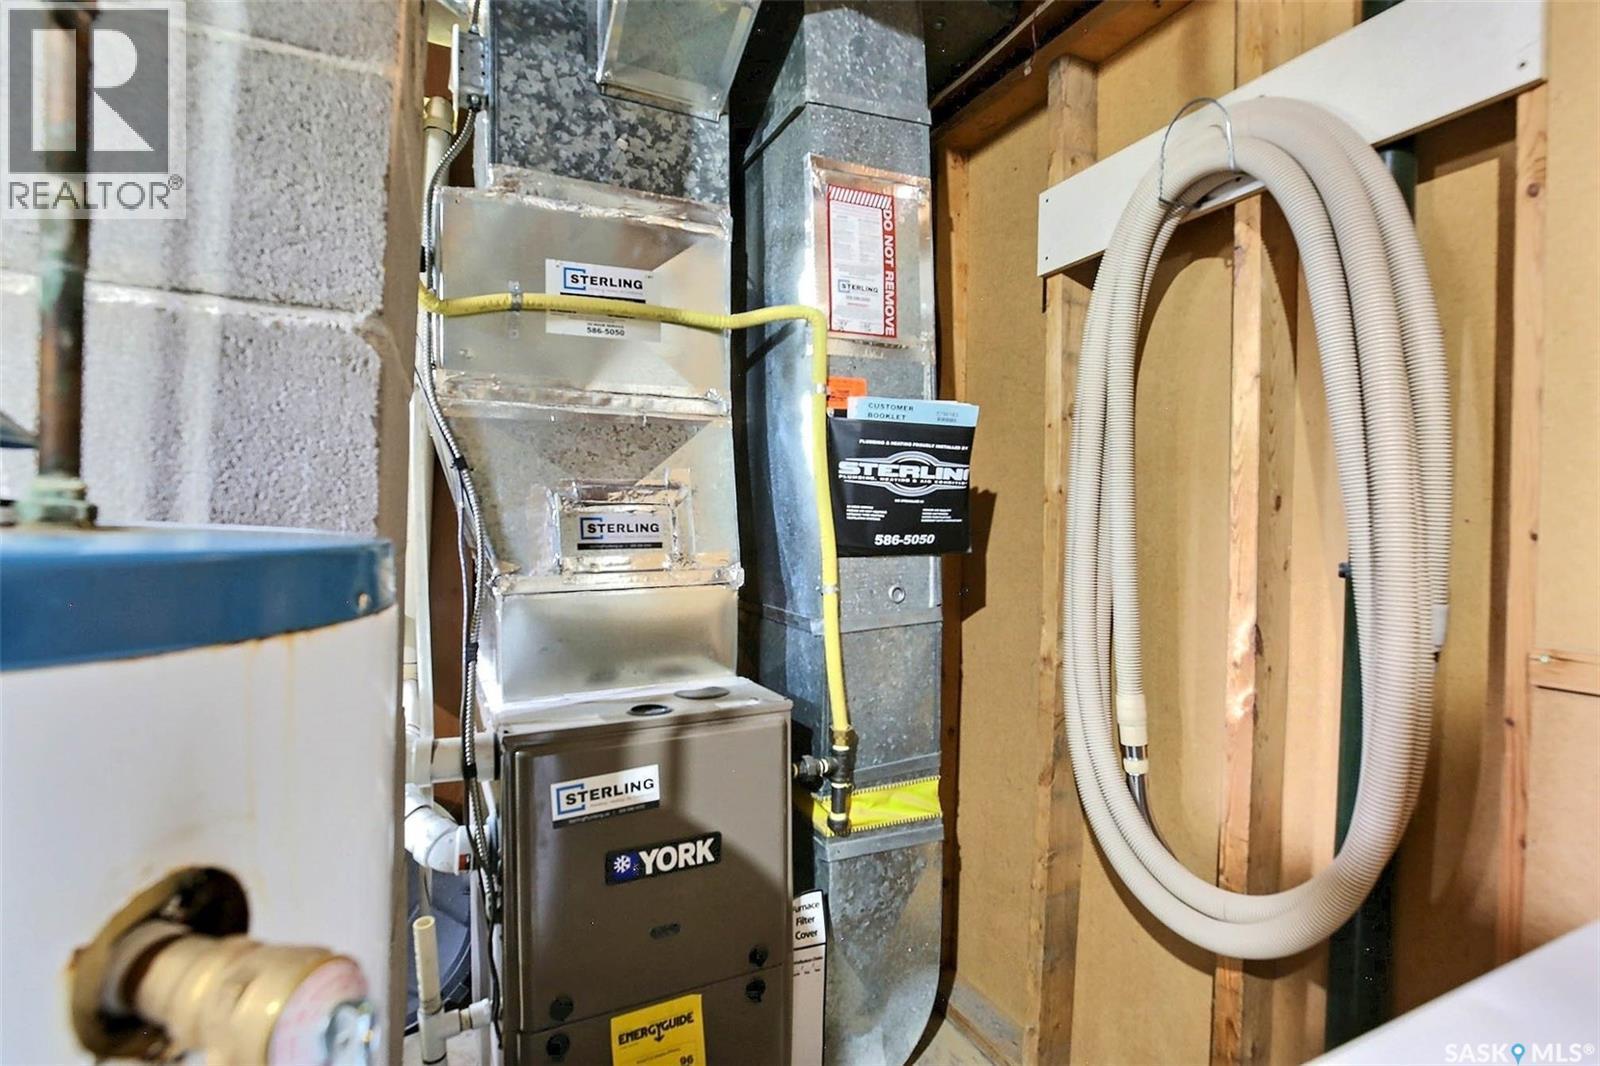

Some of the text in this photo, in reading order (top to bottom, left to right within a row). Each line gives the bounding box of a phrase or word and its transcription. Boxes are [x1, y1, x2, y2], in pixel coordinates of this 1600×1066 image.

[883, 208, 896, 336] DO NOT REMOVE
[570, 273, 643, 290] STERLING
[841, 283, 879, 293] STERLING
[586, 326, 625, 336] 586-5050
[868, 402, 914, 412] CUSTOMER
[868, 412, 906, 421] BOOKLET
[587, 523, 660, 534] STERLING
[874, 533, 936, 546] 586-5050
[565, 778, 654, 806] STERLING
[639, 837, 716, 875] YORK
[795, 915, 815, 927] Filter
[795, 929, 818, 941] Cover
[617, 1011, 694, 1045] ENERGYGUIDE
